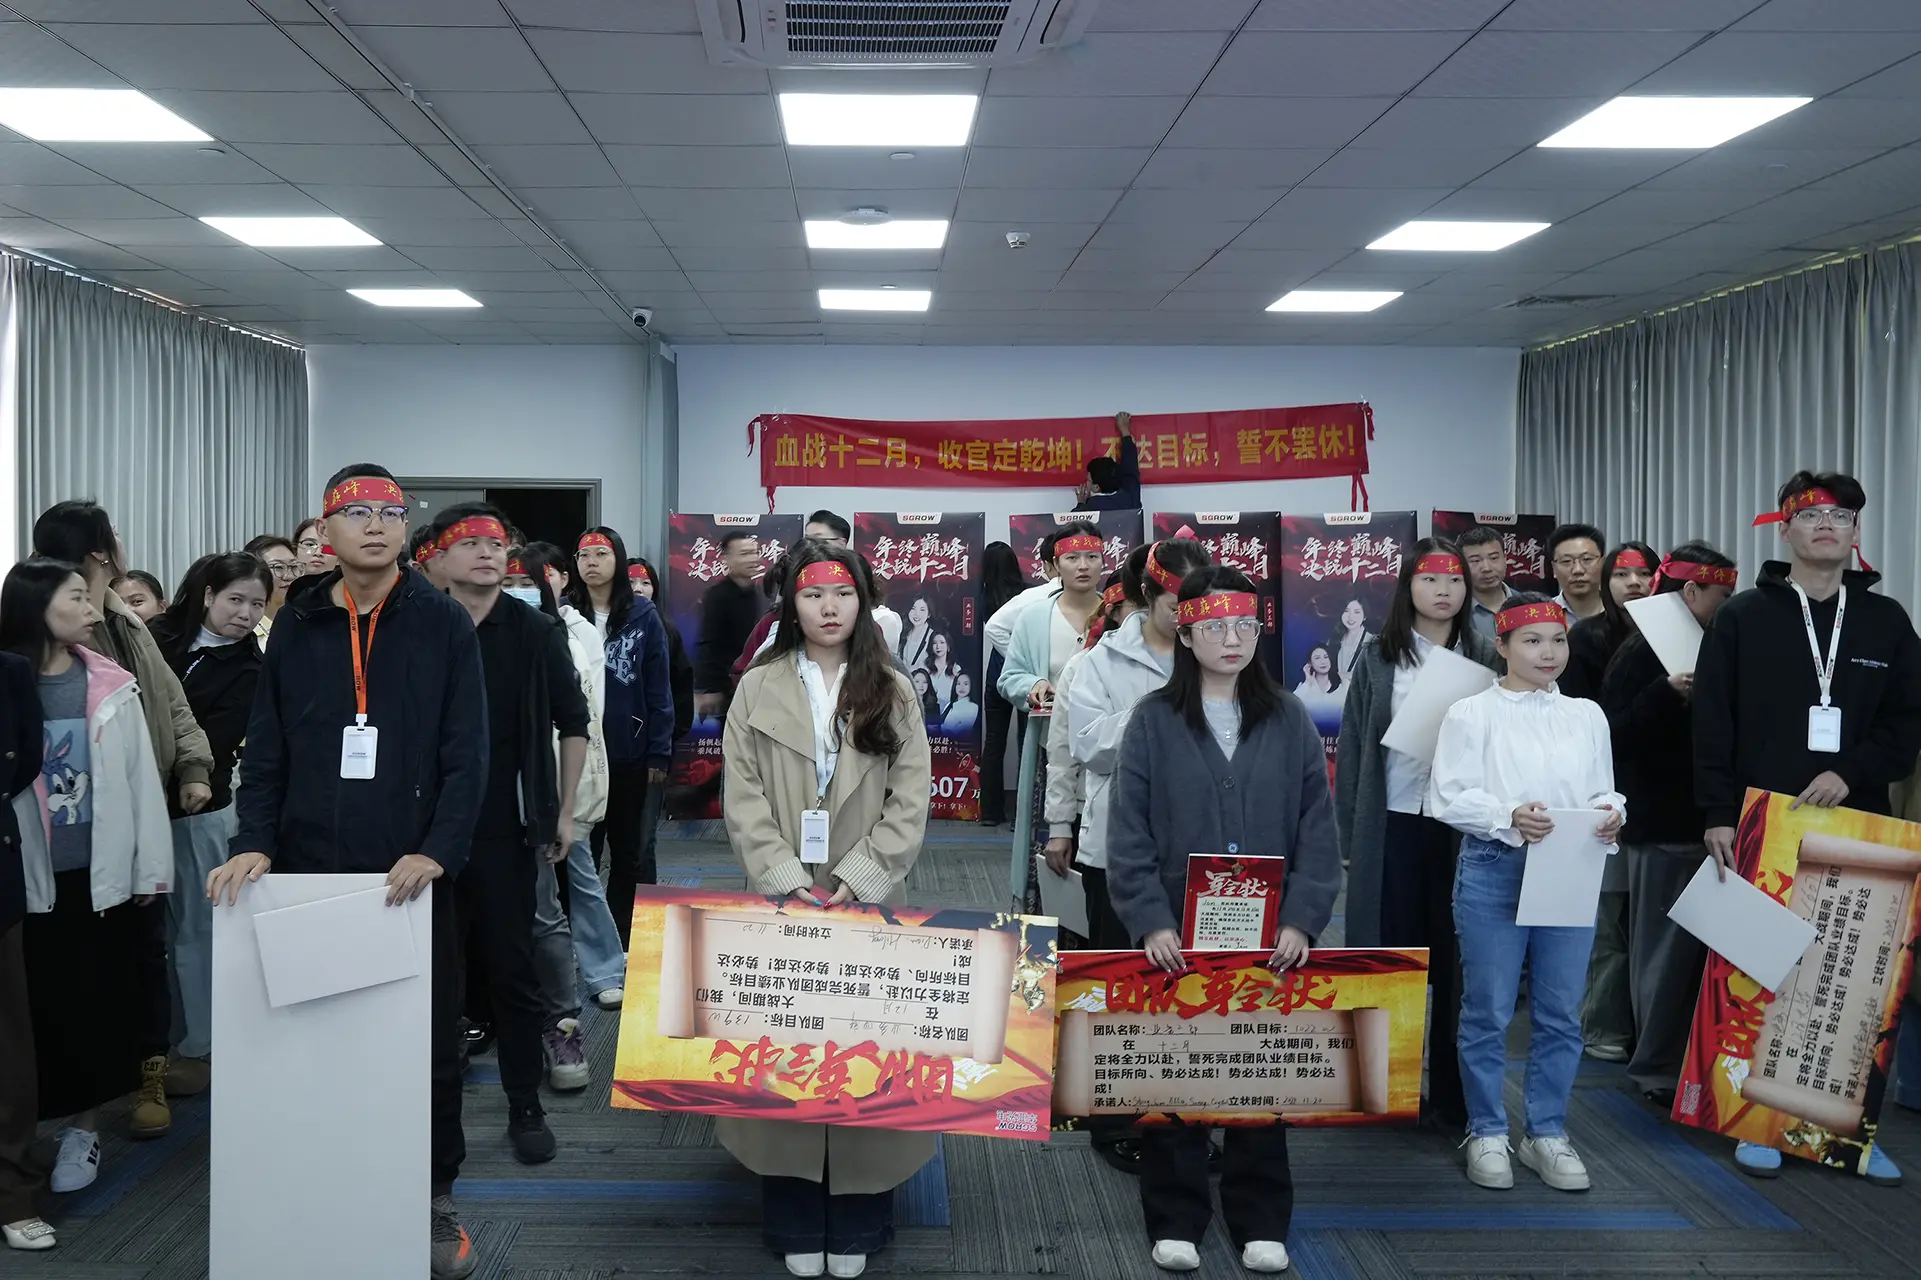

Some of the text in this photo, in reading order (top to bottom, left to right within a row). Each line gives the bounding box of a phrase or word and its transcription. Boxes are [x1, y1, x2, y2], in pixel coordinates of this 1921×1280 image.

[1060, 514, 1093, 522] SGROW
[690, 535, 785, 564] 年峰
[873, 533, 966, 563] 年终巅峰
[1201, 533, 1265, 562] 终巅峰
[1301, 533, 1400, 563] 年终巅峰
[872, 555, 969, 583] 决战十二月
[1300, 554, 1402, 583] 决战十二月
[778, 924, 832, 939] 立状时间：
[934, 936, 973, 950] 承诺人：
[952, 954, 971, 967] 成！
[722, 972, 970, 1004] 定将全力以赴，誓死完成团队业绩目标。
[696, 989, 794, 1008] 大战期间，我们
[925, 1006, 939, 1020] 在
[764, 1013, 824, 1030] 团队目标：
[913, 1024, 969, 1041] 团队名称：
[1093, 1024, 1146, 1036] 团队名称：
[1230, 1023, 1288, 1035] 团队目标：
[1122, 1040, 1135, 1051] 在
[1259, 1038, 1355, 1050] 大战期间，我们
[1786, 1046, 1798, 1058] 在
[144, 1061, 161, 1071] CAT
[1094, 1053, 1331, 1066] 定将全力以赴，誓死完成团队业绩目标。
[1094, 1083, 1112, 1094] 成！
[1093, 1097, 1132, 1108] 承诺人：
[1229, 1095, 1279, 1106] 立状时间：
